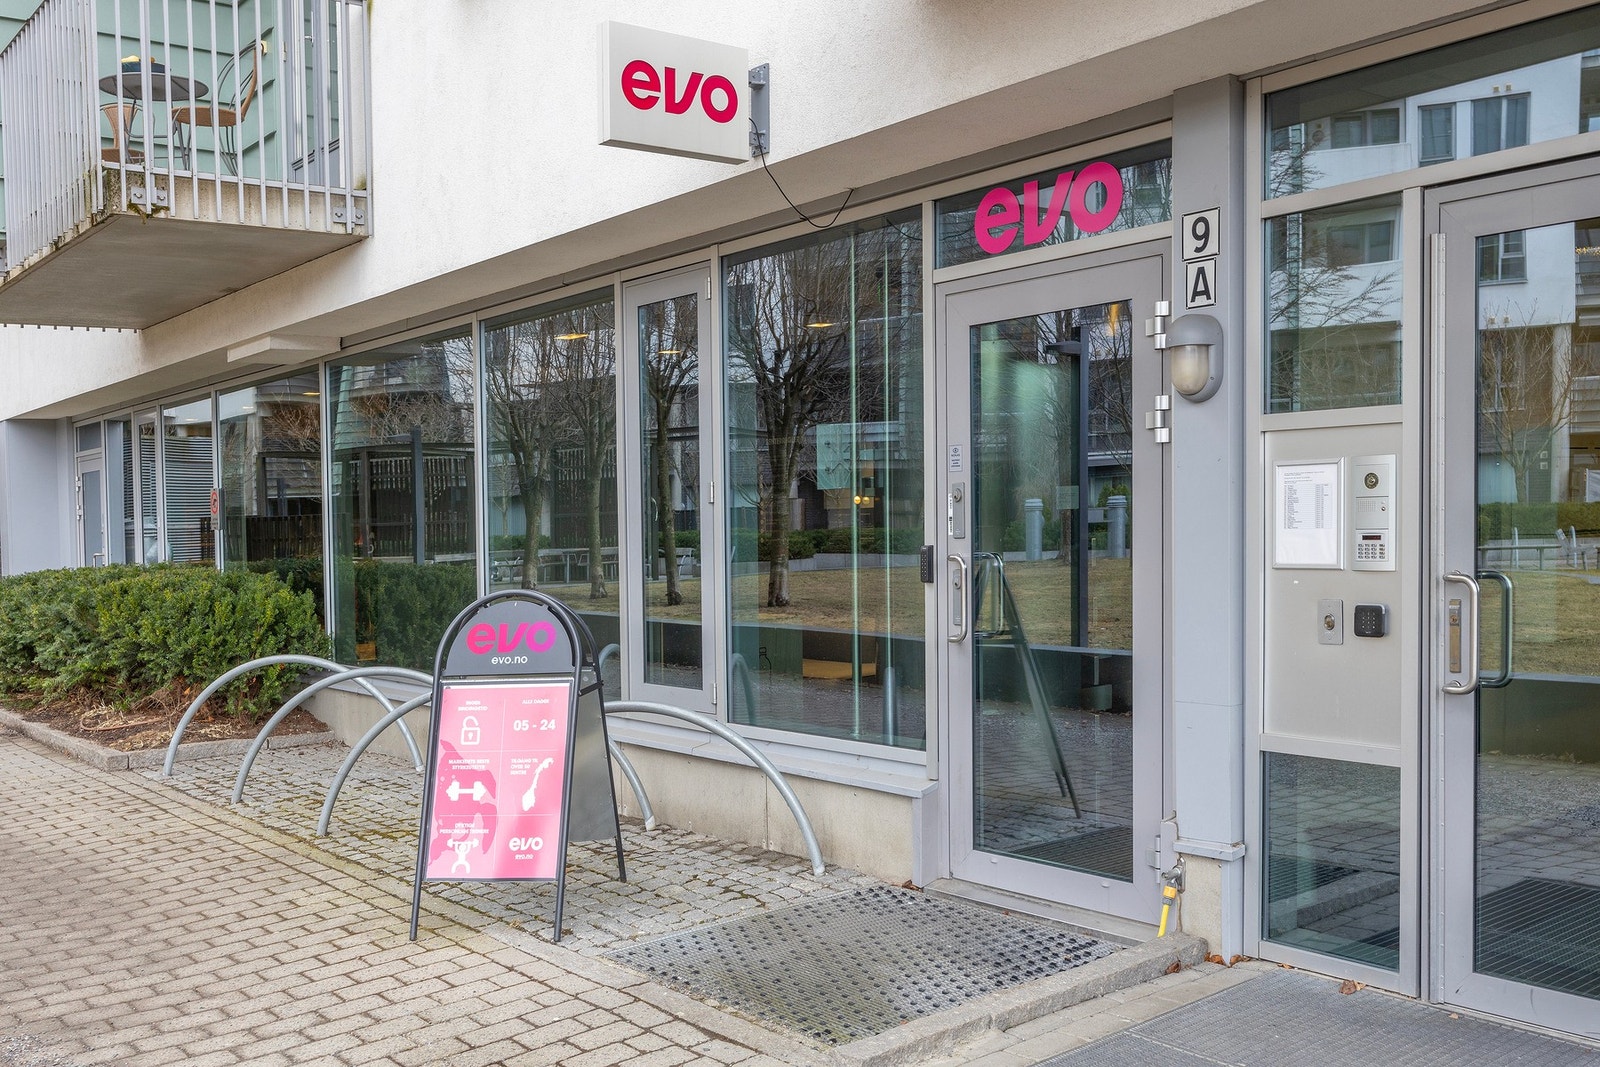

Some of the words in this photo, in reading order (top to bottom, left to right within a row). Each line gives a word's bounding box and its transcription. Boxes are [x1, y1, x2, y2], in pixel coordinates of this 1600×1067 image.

[621, 59, 738, 124] evo
[974, 161, 1123, 255] evo
[1191, 216, 1210, 253] 9
[1190, 266, 1211, 303] A
[466, 621, 556, 655] evo
[491, 655, 528, 666] evo.no
[513, 719, 530, 732] 05
[539, 719, 556, 731] 24
[508, 836, 544, 852] evo
